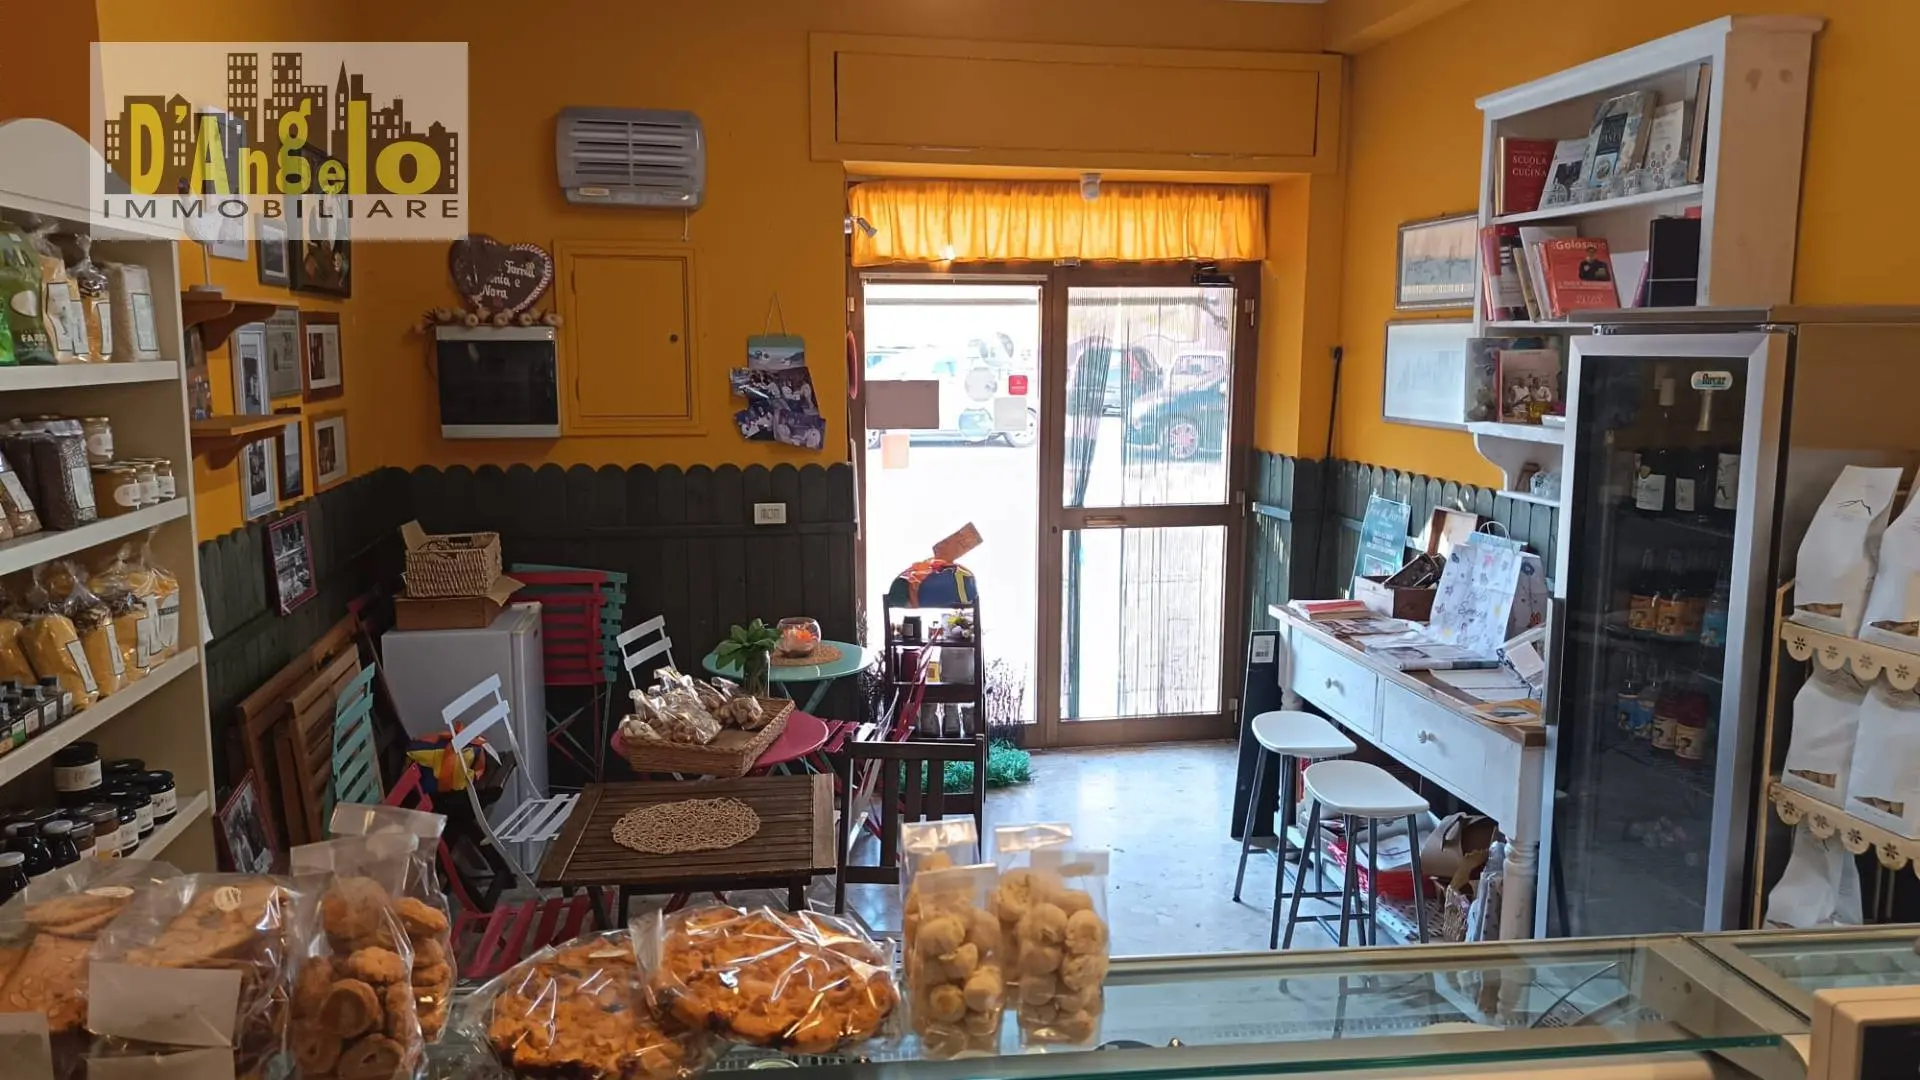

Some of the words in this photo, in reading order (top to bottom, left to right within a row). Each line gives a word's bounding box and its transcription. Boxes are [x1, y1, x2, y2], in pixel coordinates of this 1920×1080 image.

[1512, 154, 1547, 166] SCUOLA
[1512, 167, 1547, 178] CUCINA
[481, 285, 508, 299] Nora
